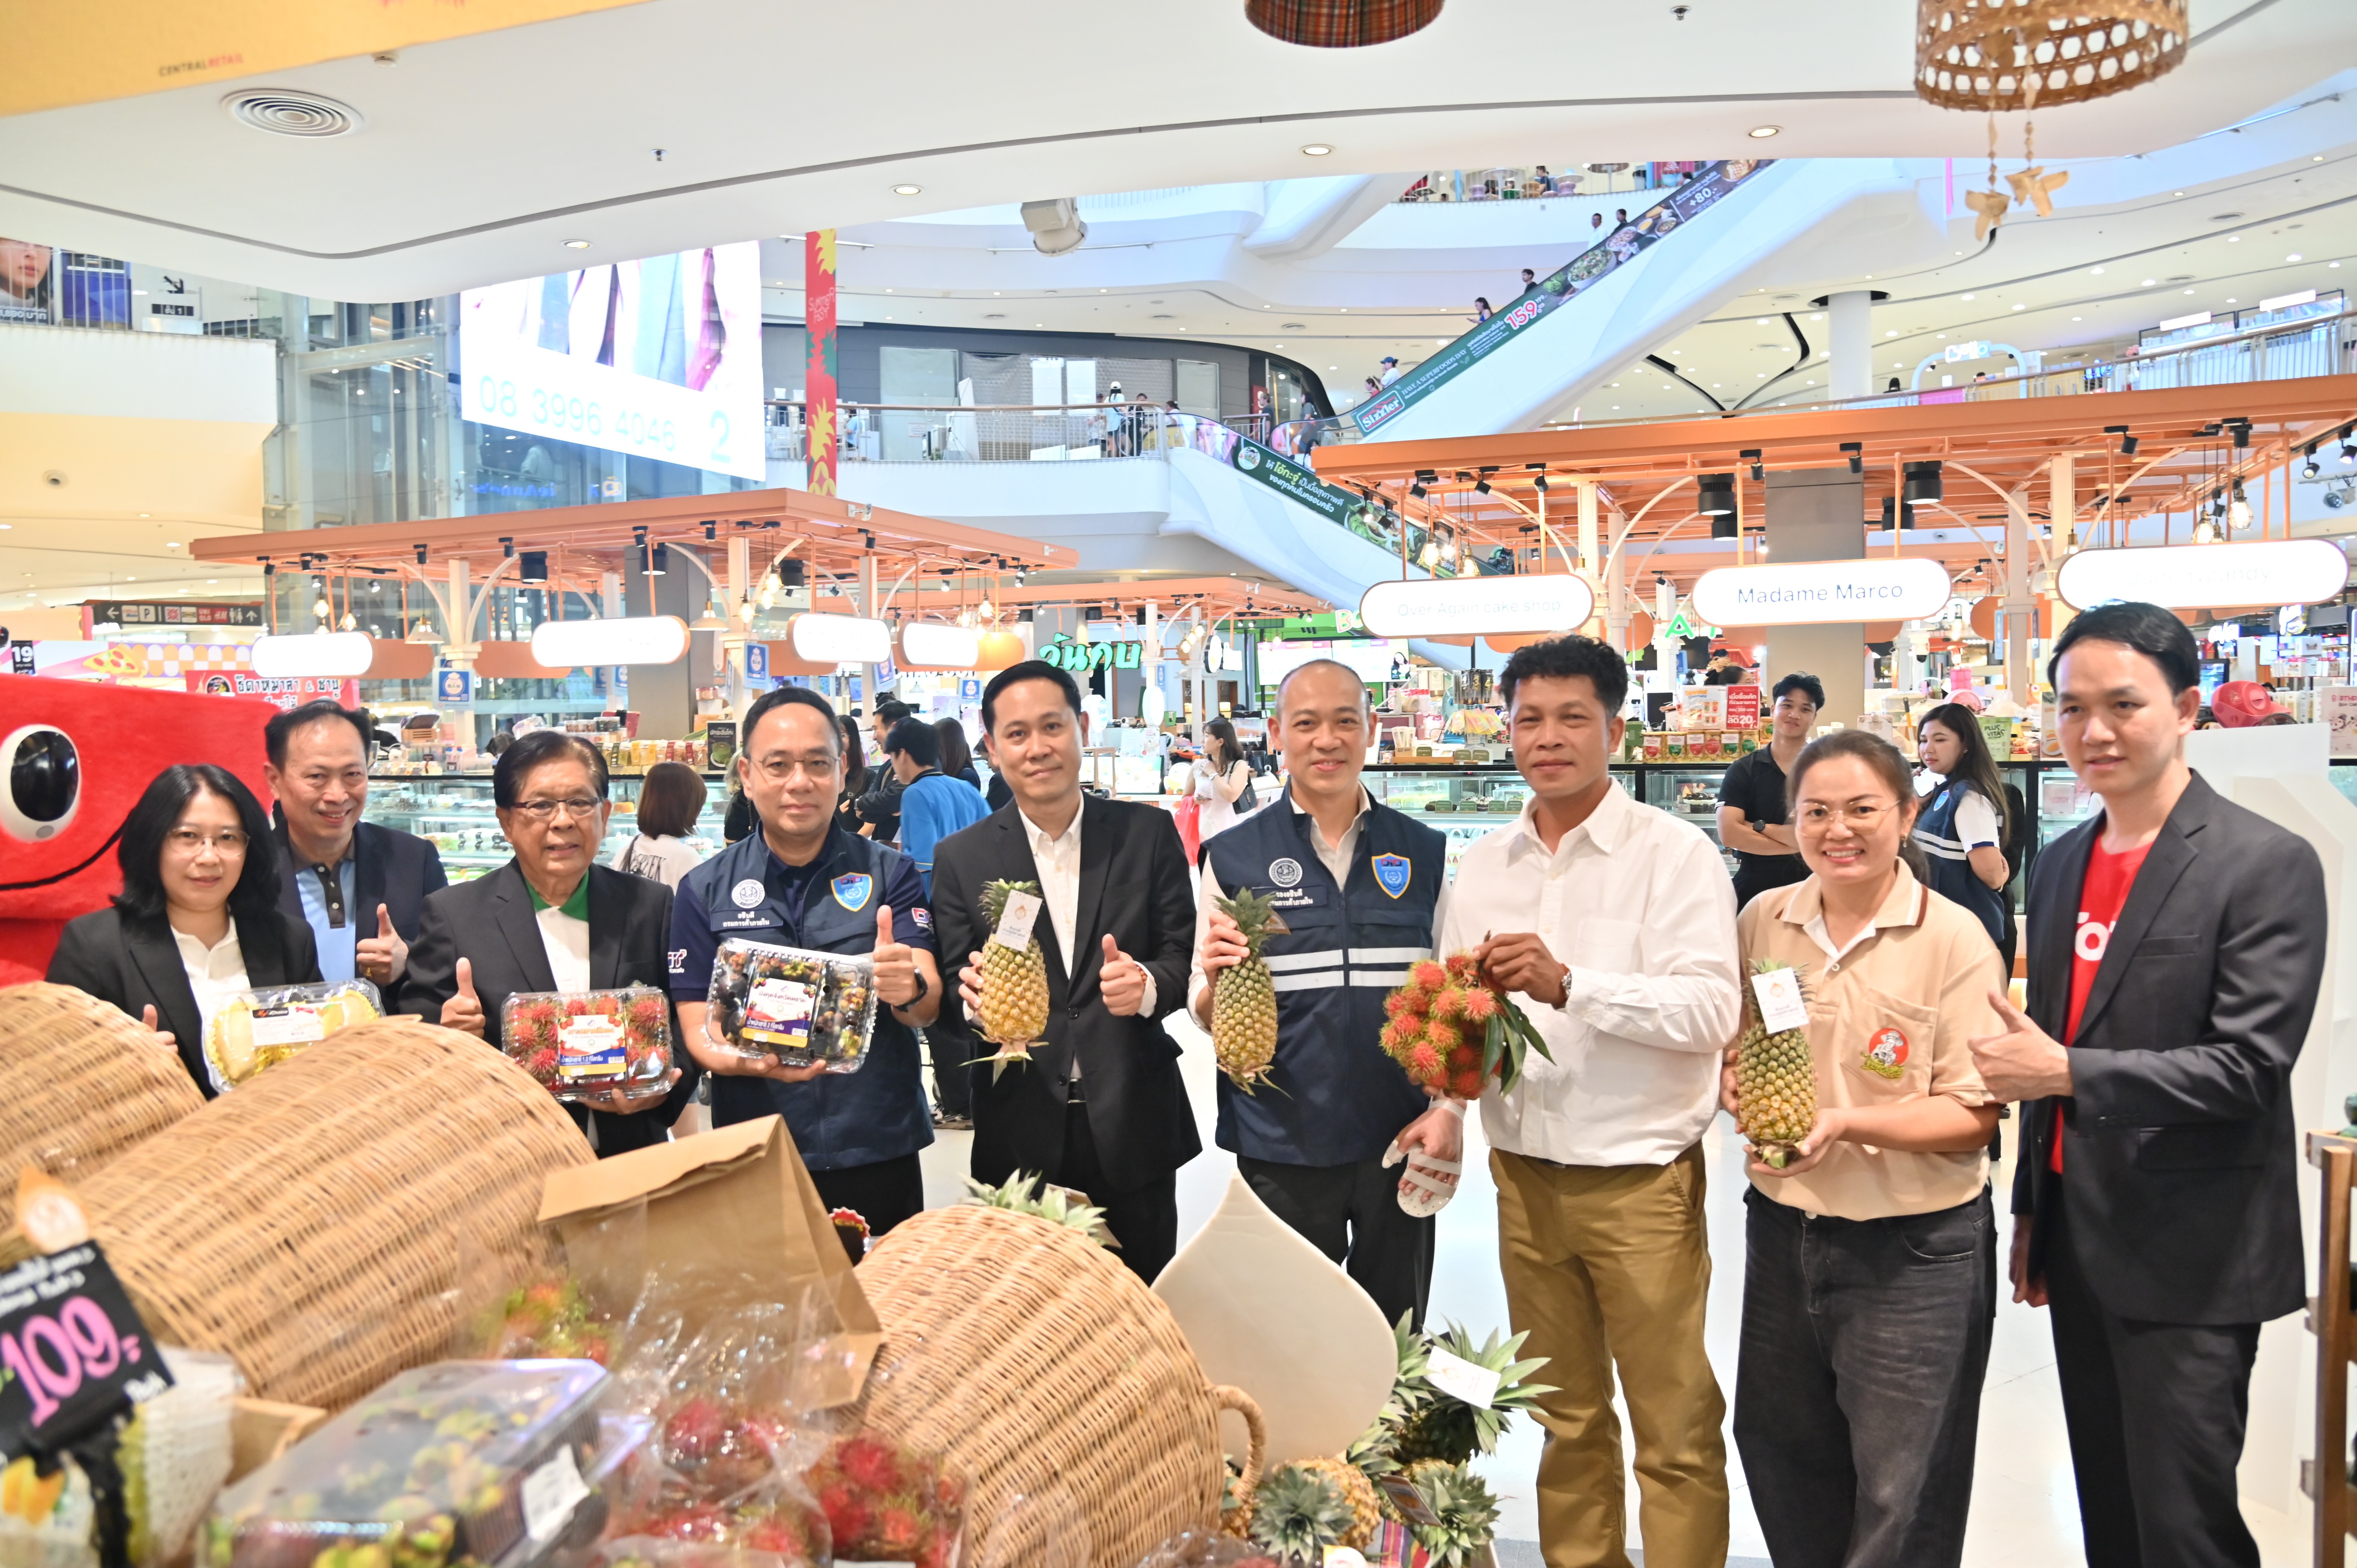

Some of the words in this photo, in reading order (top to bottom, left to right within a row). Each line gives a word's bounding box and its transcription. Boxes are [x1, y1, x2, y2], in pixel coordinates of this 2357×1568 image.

[479, 375, 517, 417] 08
[533, 388, 602, 436] 3996
[615, 410, 676, 452] 4046
[1362, 397, 1400, 430] Sizzler
[1269, 474, 1334, 512] ของทุกคนในครอบครัว
[1738, 585, 1828, 603] Madame
[1836, 583, 1903, 600] Marco
[144, 608, 150, 620] P
[1398, 603, 1431, 616] Over
[1438, 602, 1478, 617] Again
[1483, 600, 1518, 613] cake
[1523, 599, 1561, 612] shop
[11, 646, 33, 662] 19
[306, 680, 314, 692] &
[723, 917, 770, 927] กรมการค้าภายใน
